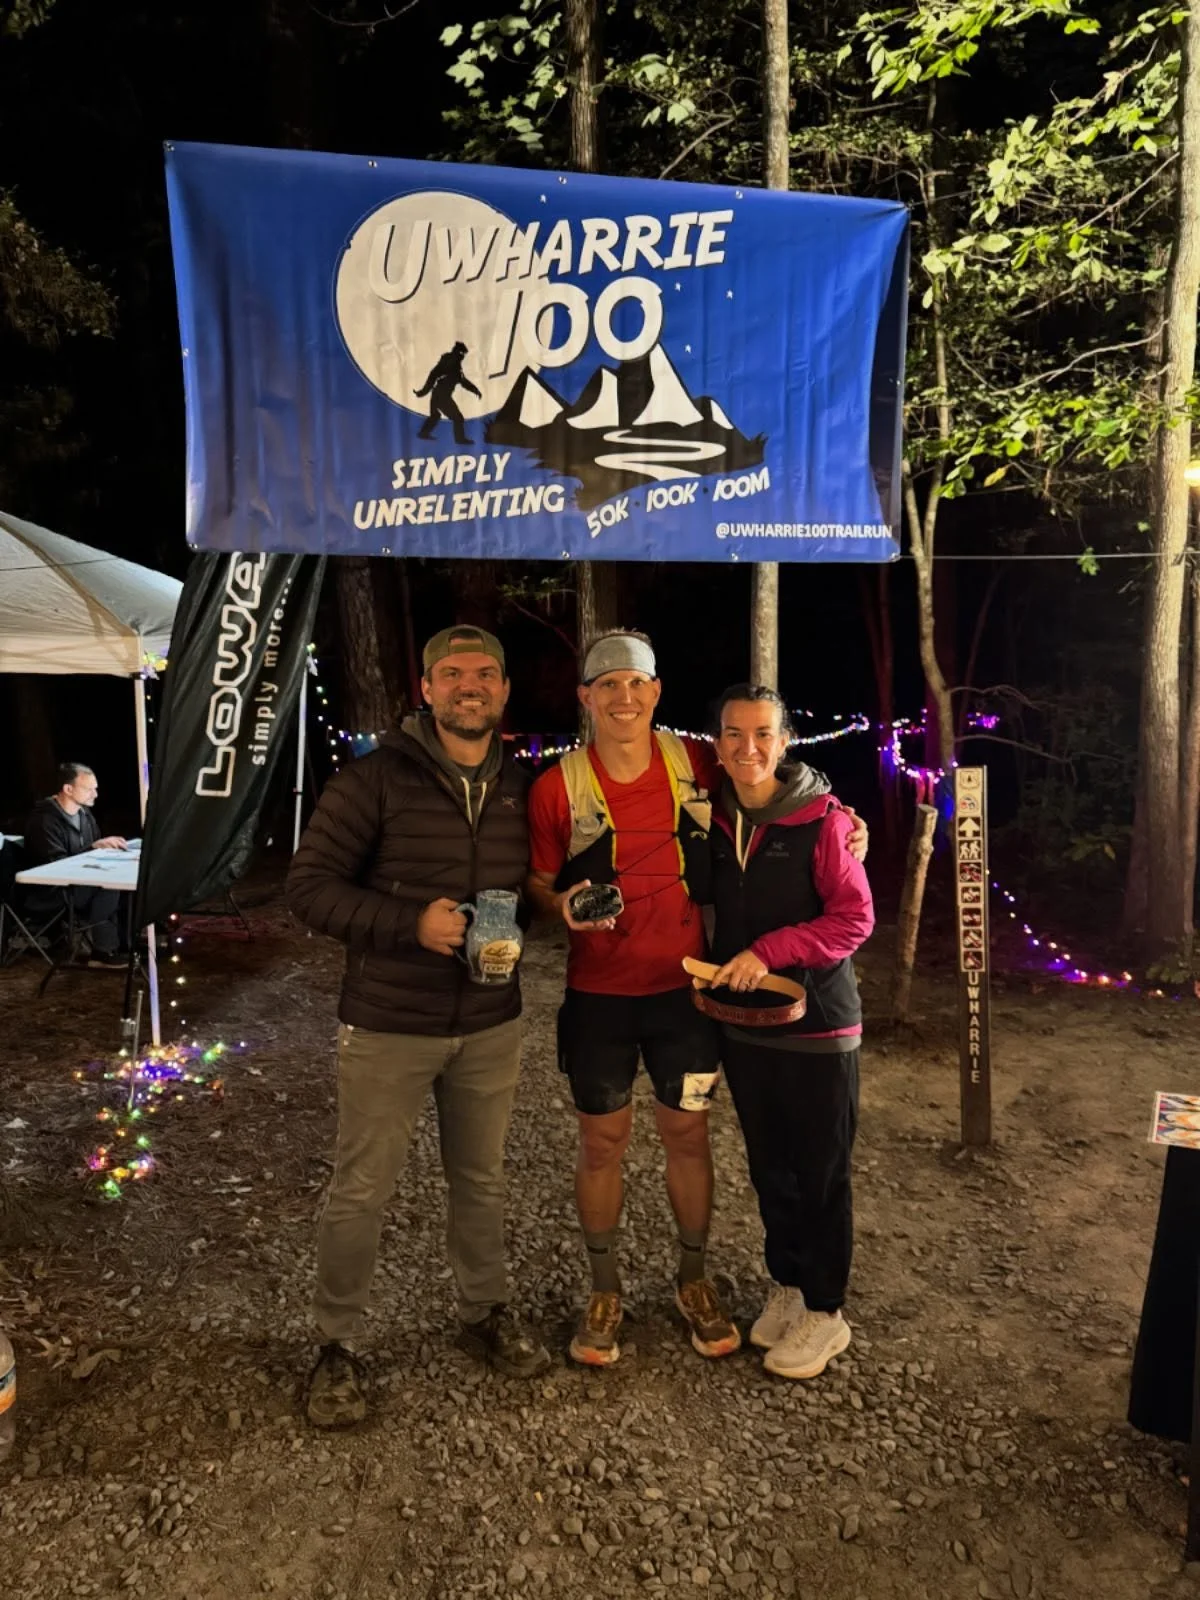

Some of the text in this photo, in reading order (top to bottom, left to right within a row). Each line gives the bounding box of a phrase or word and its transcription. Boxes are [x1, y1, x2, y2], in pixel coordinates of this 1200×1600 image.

[367, 209, 734, 303] UWHARRIE
[489, 275, 664, 379] 100
[352, 484, 565, 531] UNRELENTING
[391, 451, 511, 489] SIMPLY
[586, 466, 771, 539] 50K 100K 100M
[715, 522, 893, 540] @UWHARRIE100TRAILRUN
[247, 680, 279, 767] simply
[967, 972, 980, 1083] UWHARRIE
